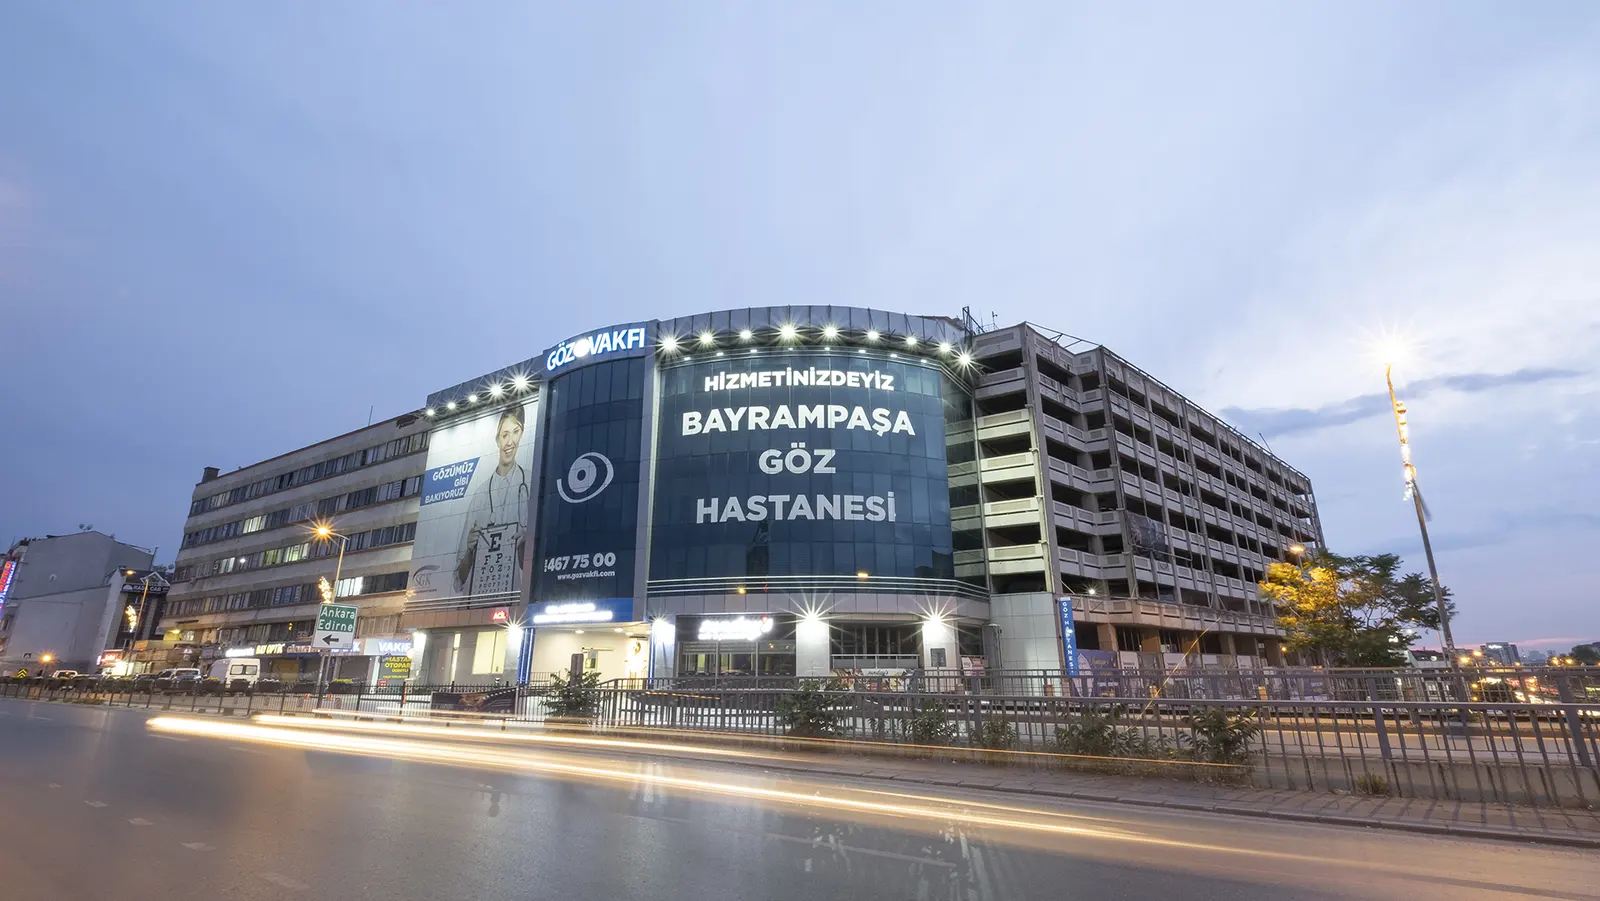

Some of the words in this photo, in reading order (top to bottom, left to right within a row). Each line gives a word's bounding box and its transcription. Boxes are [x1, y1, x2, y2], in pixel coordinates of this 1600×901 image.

[547, 341, 576, 371] GÖZ
[588, 328, 646, 355] VAKFI
[704, 367, 894, 392] HİZMETİNİZDEYİZ
[682, 404, 916, 437] BAYRAMPAŞA
[758, 442, 836, 475] GÖZ
[432, 462, 475, 481] GÖZÜMÜZ
[454, 475, 470, 487] GİBİ
[424, 487, 465, 503] BAKIYORUZ
[696, 491, 896, 524] HASTANESİ
[488, 532, 502, 552] E
[547, 556, 570, 572] 467
[572, 554, 590, 569] 75
[593, 552, 616, 567] 00
[320, 606, 355, 619] Ankara
[318, 619, 353, 632] Edirne
